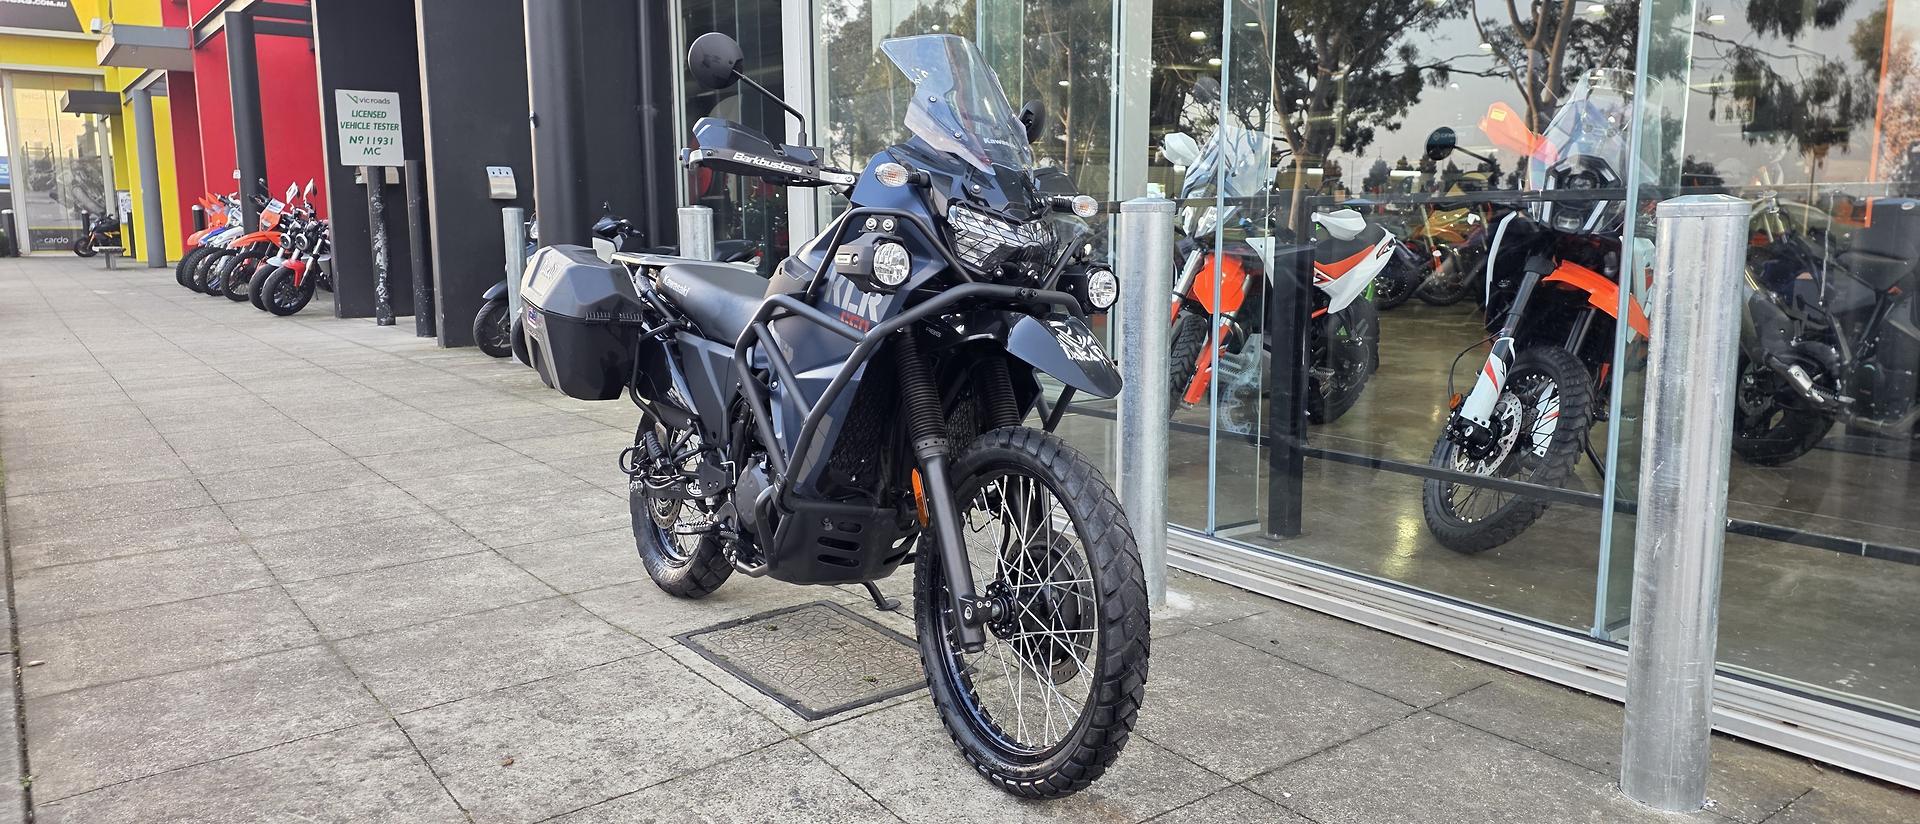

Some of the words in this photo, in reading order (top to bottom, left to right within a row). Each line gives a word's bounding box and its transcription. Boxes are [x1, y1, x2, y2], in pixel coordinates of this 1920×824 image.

[351, 110, 387, 119] LICENSED
[340, 121, 371, 130] VEHICLE
[373, 123, 400, 131] TESTER
[366, 136, 394, 145] 11931
[363, 147, 382, 156] MC
[732, 151, 803, 173] Barkbusters
[44, 236, 69, 244] cardo
[662, 274, 691, 297] Kawasaki
[824, 263, 895, 323] KLR
